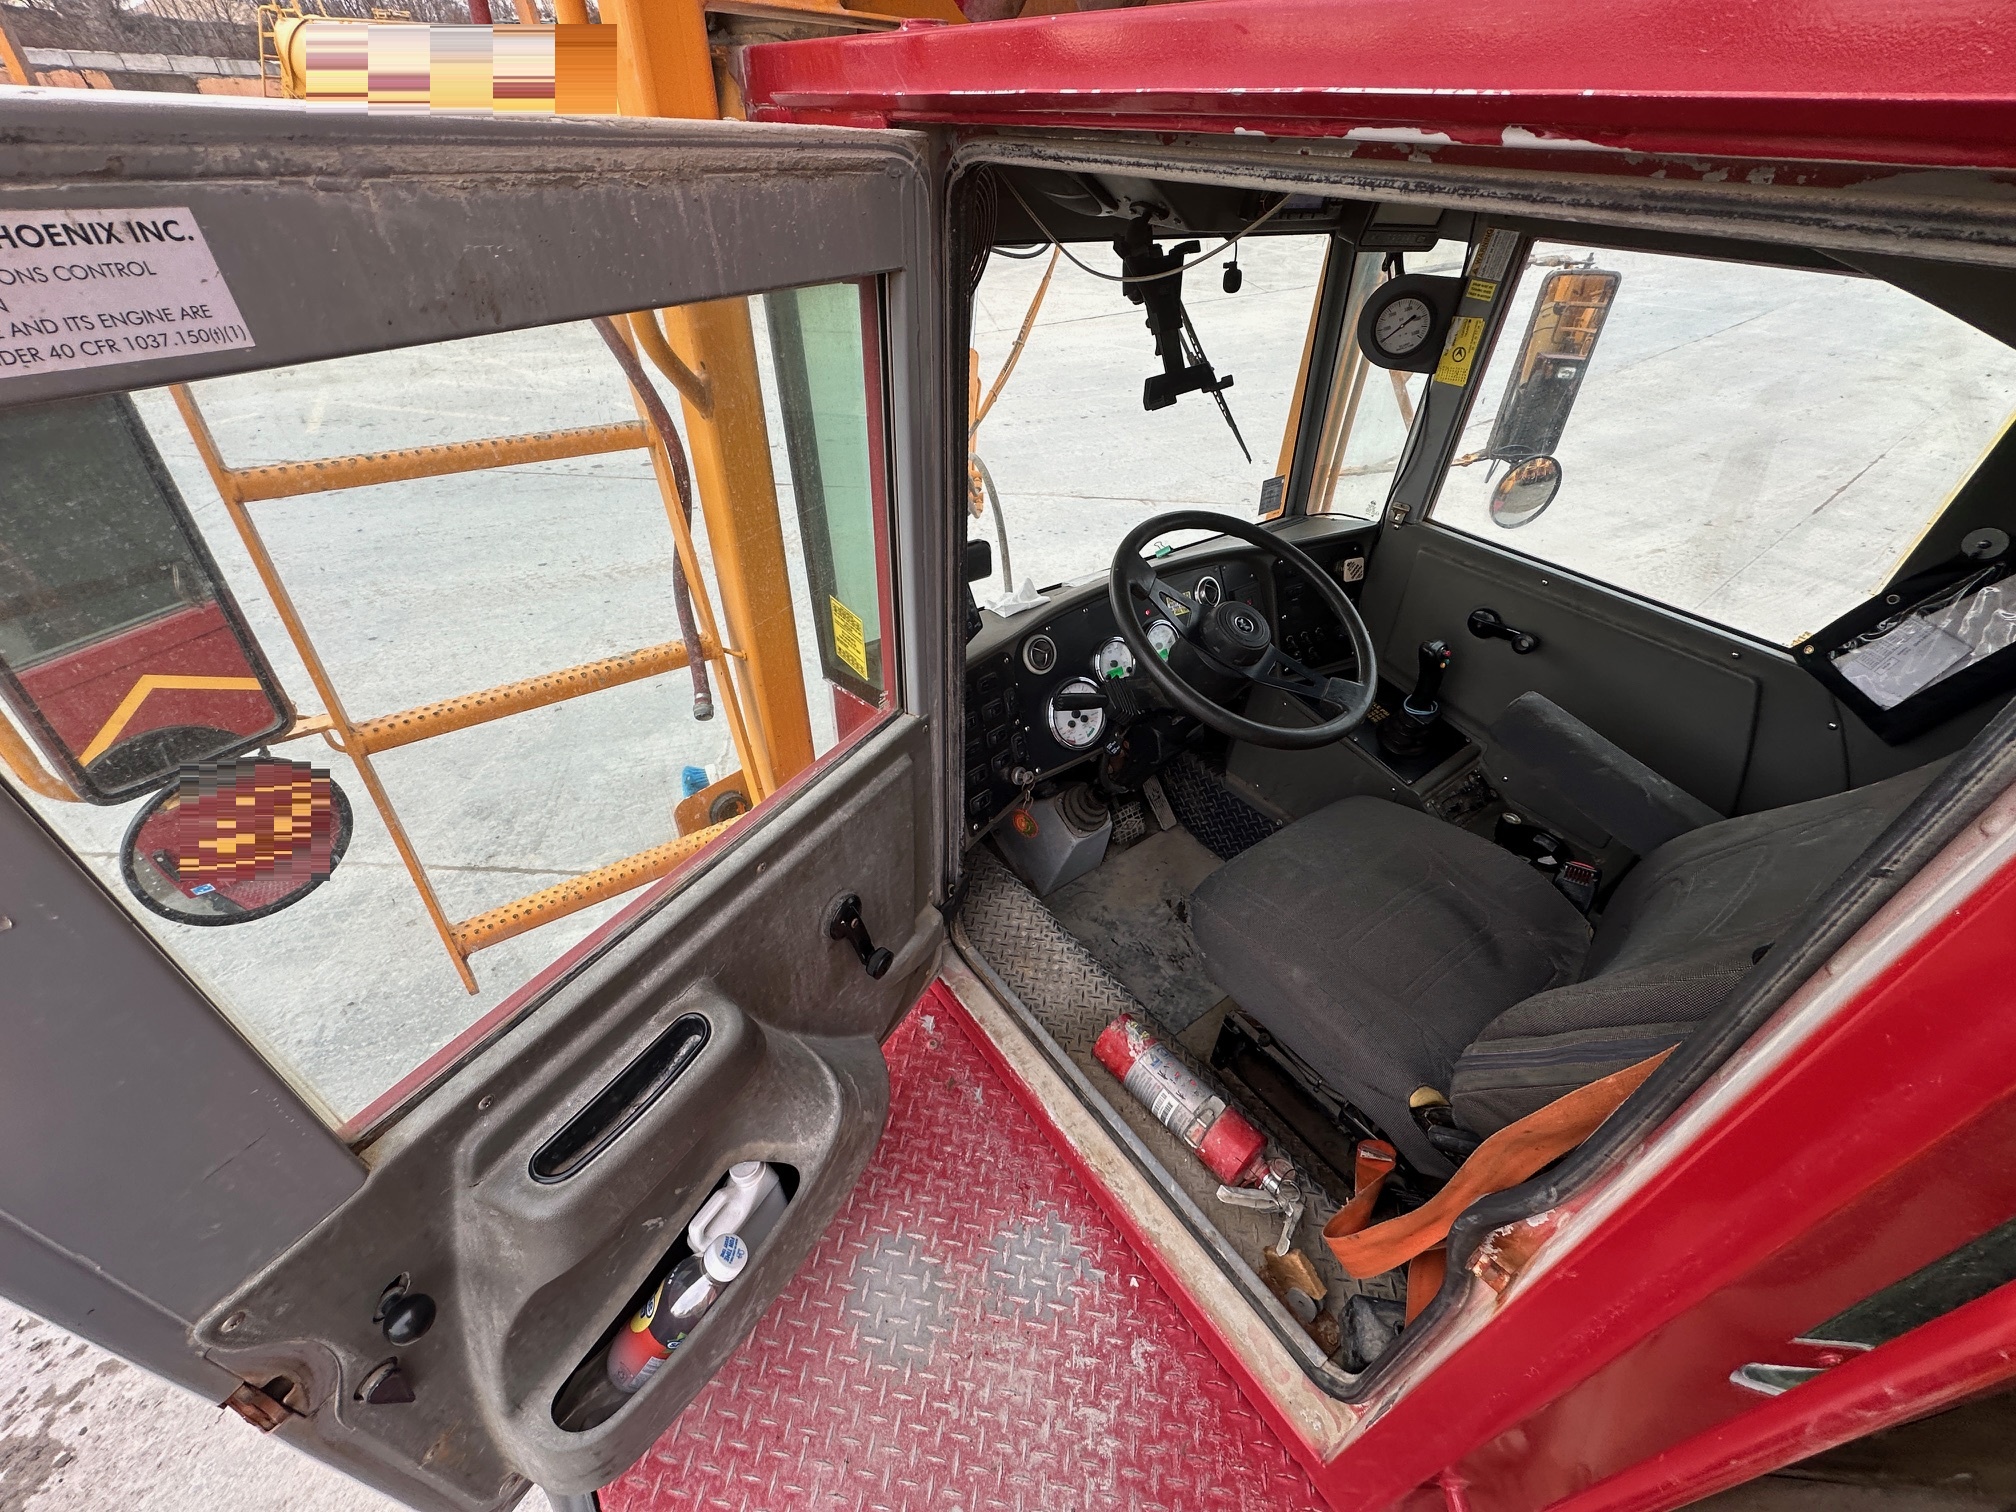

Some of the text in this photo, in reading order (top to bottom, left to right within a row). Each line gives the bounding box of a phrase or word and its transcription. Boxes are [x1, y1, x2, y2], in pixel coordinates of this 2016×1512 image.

[126, 219, 195, 243] INC.
[1475, 228, 1494, 264] WARNING
[0, 260, 157, 285] ONS CONTROL
[11, 304, 213, 338] AND ITS ENGINE ARE
[0, 347, 46, 367] DER
[49, 343, 76, 360] 40
[80, 338, 122, 356] CFR
